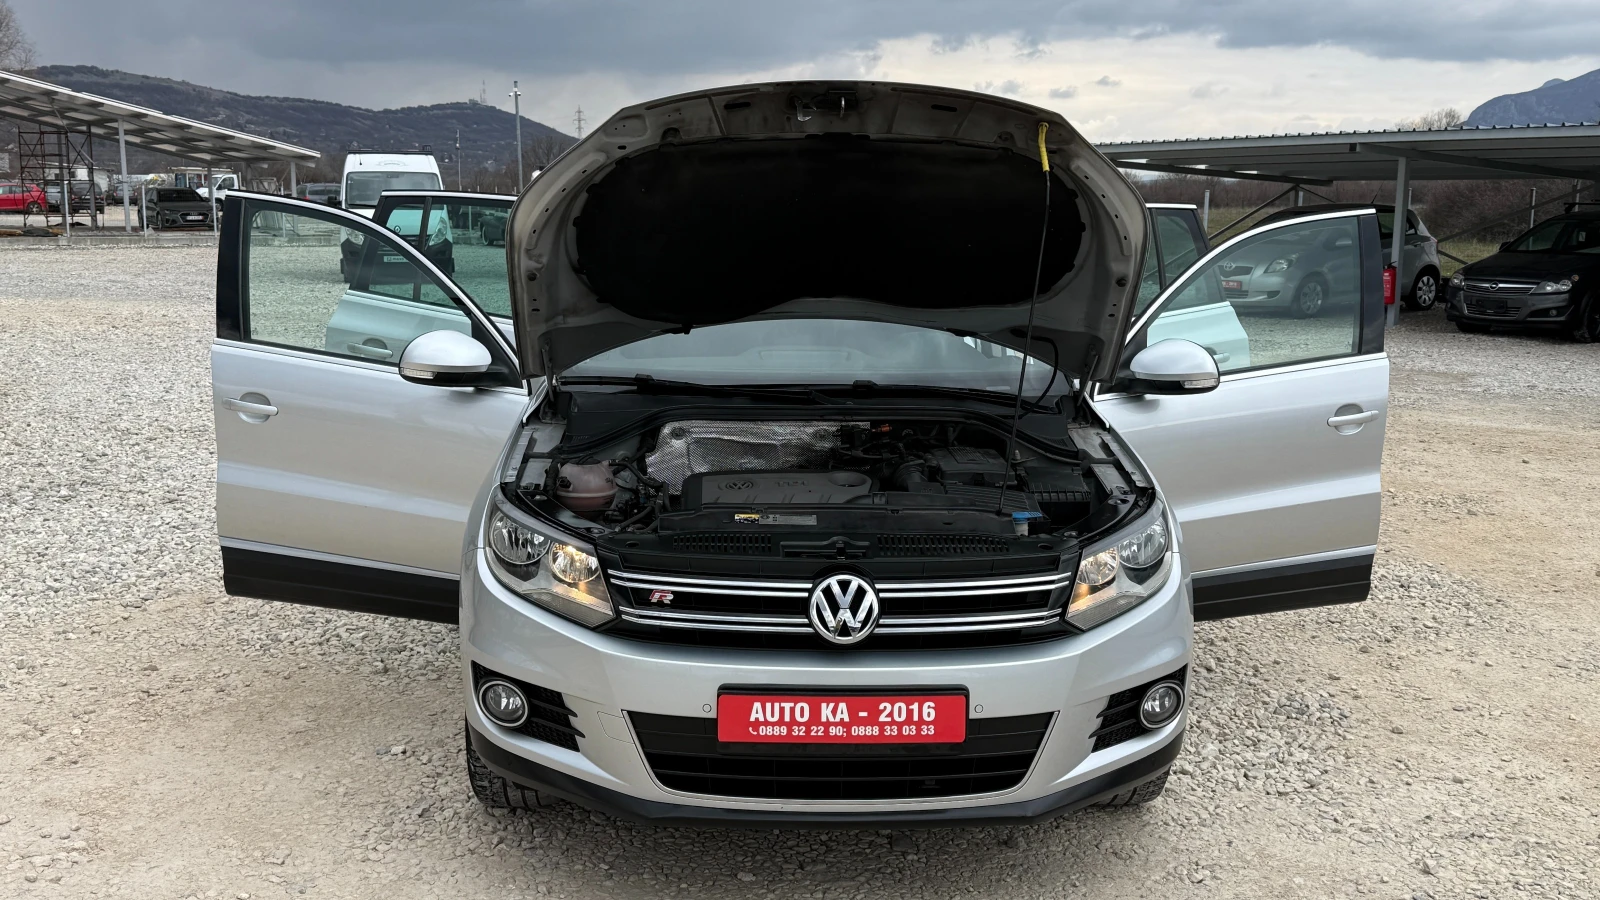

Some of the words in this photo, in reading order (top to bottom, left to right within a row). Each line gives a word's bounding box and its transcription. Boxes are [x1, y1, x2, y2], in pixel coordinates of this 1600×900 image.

[649, 589, 674, 604] R
[809, 574, 879, 645] VW
[749, 702, 810, 722] AUTO
[820, 702, 850, 722] KA
[878, 701, 936, 722] 2016
[758, 726, 787, 736] 0889
[791, 726, 806, 736] 32
[810, 726, 825, 736] 22
[829, 726, 847, 738] 90;
[851, 726, 880, 736] 0888
[884, 726, 898, 736] 33
[902, 725, 917, 736] 03
[920, 725, 935, 735] 33
